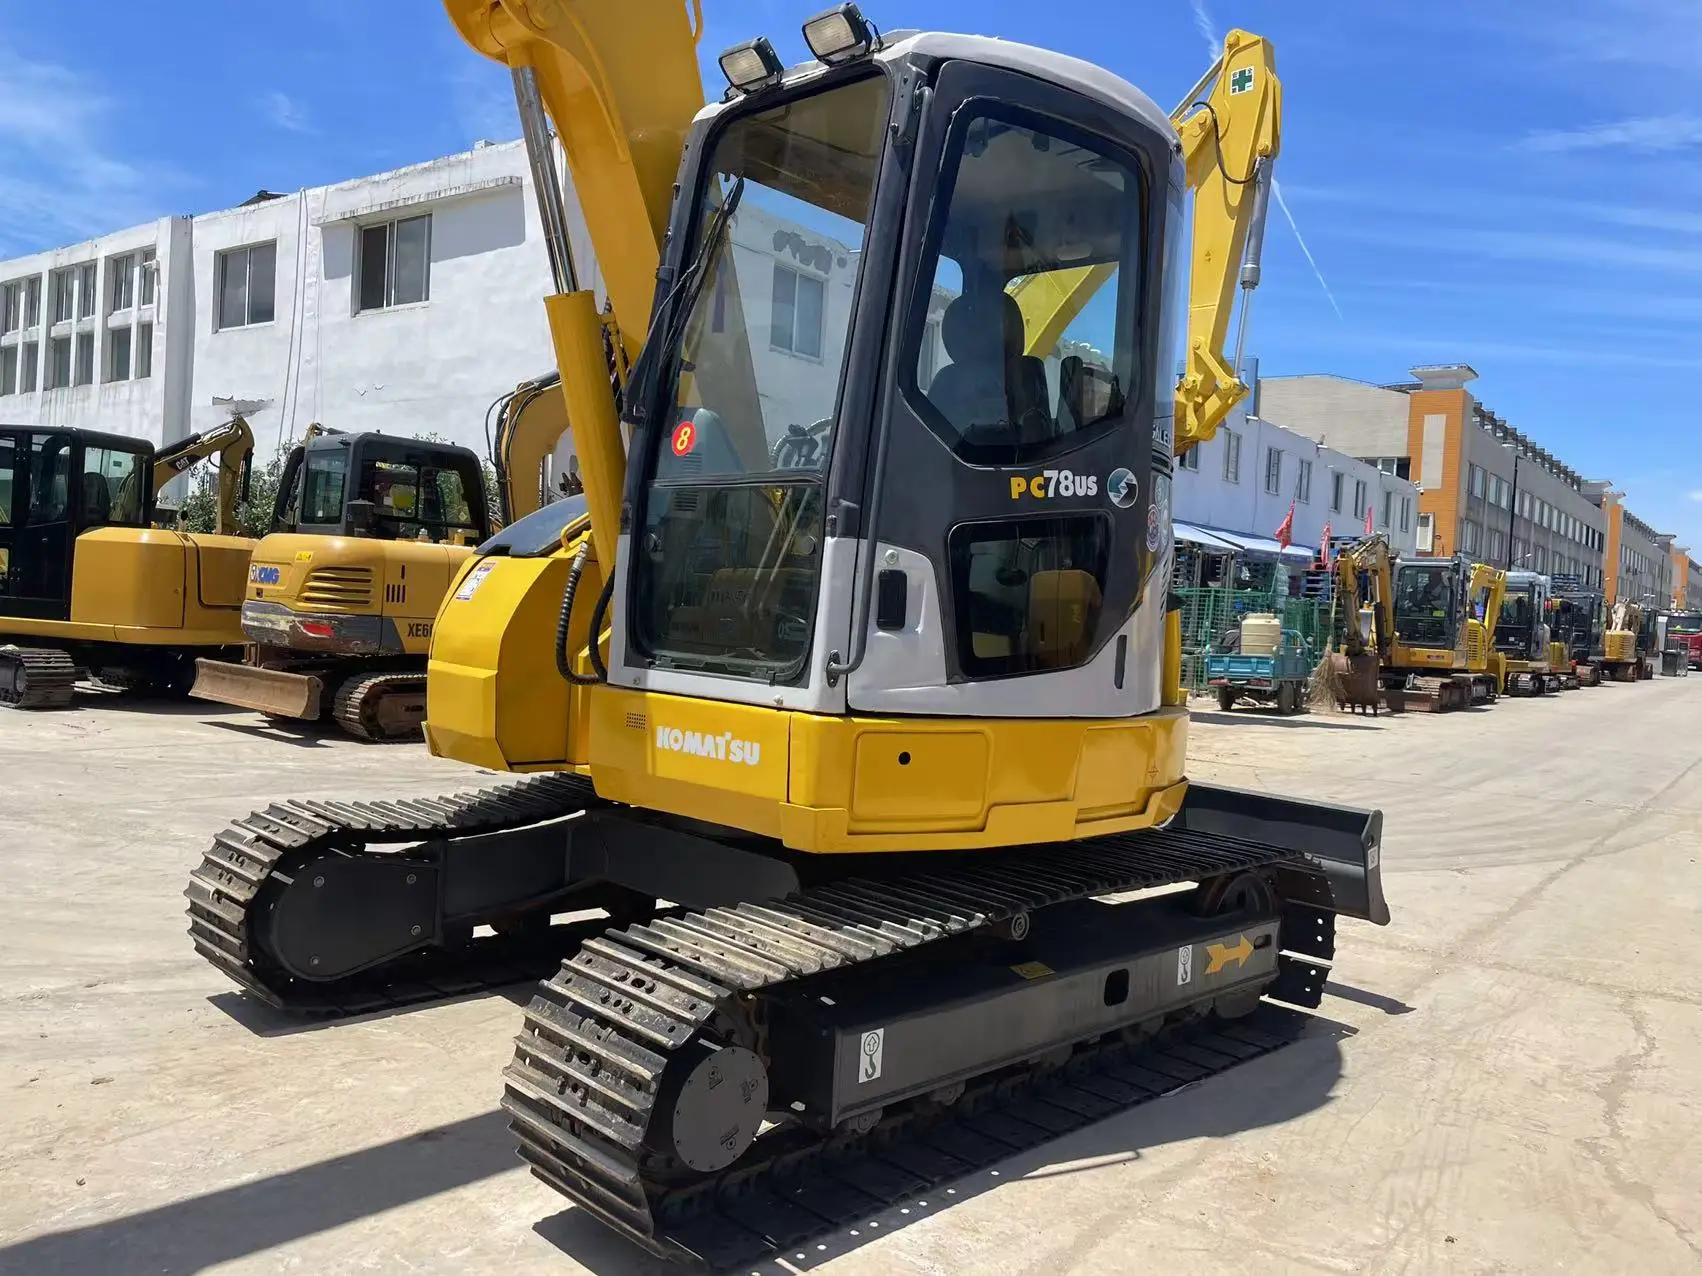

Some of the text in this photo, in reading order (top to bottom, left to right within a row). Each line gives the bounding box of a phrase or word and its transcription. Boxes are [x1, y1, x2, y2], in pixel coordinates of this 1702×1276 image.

[676, 426, 691, 451] 8
[175, 456, 190, 470] CAT
[1010, 469, 1098, 499] PC78US
[656, 725, 760, 766] KOMATSU
